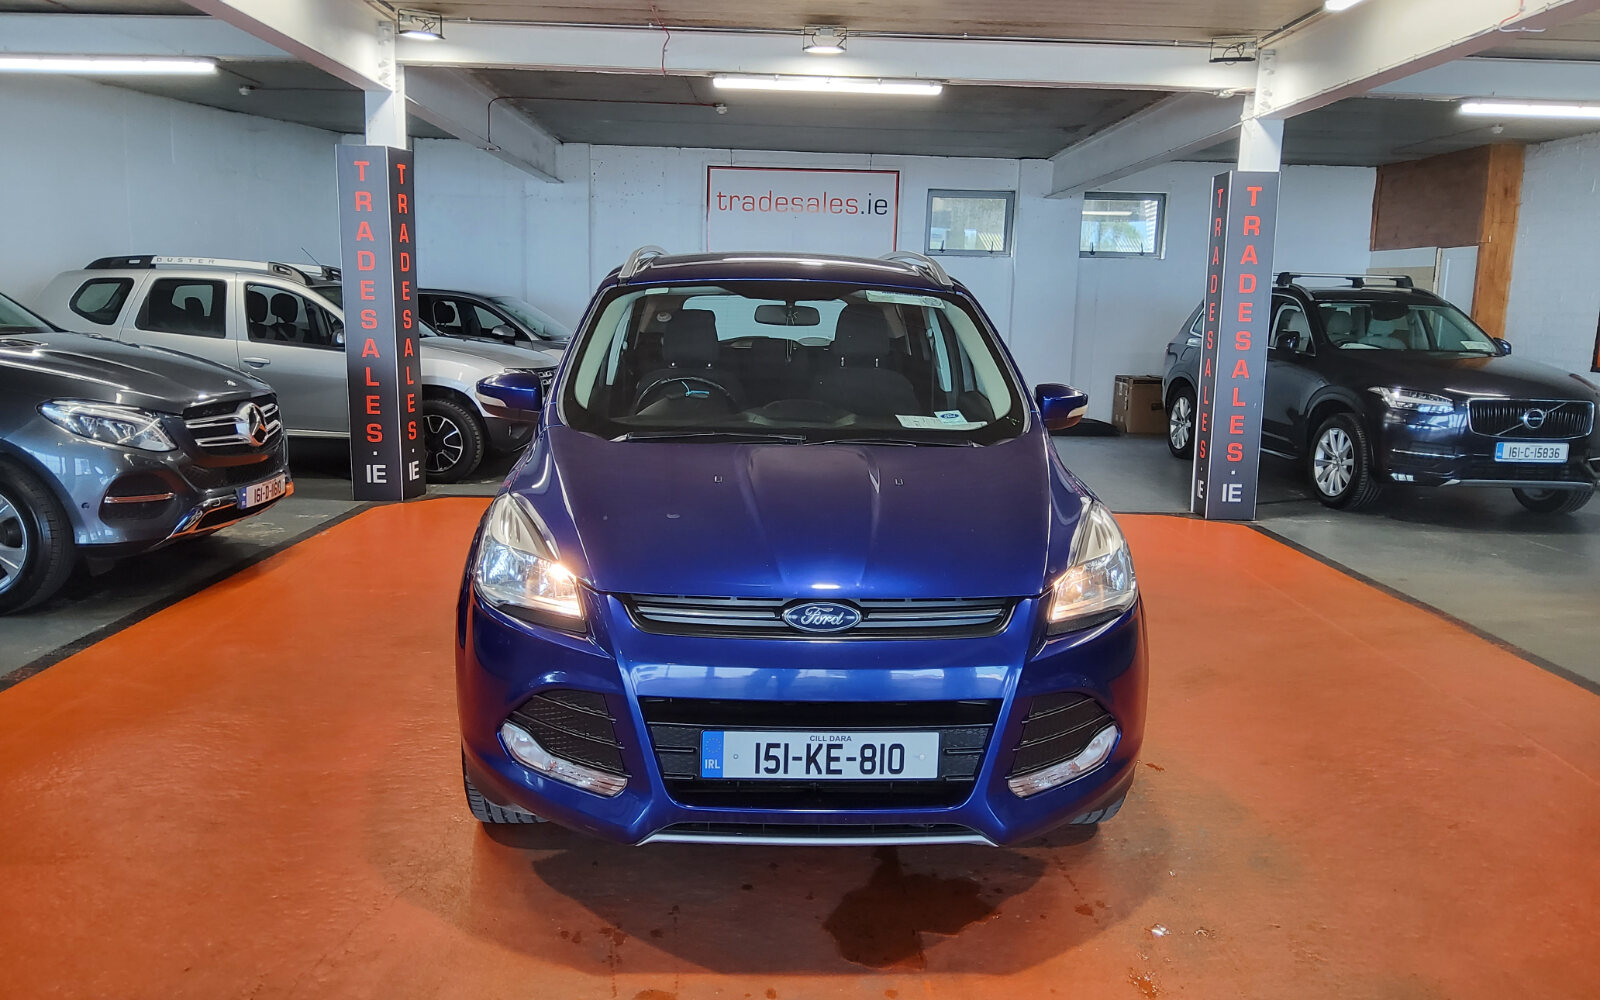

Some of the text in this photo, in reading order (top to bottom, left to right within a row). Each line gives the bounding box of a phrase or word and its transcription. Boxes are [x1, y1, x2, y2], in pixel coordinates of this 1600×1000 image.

[717, 190, 888, 215] tradesales.ie
[1508, 446, 1560, 459] 161-C-15836
[800, 606, 845, 626] Ford
[704, 759, 721, 769] IRL
[754, 743, 905, 775] 151-KE-810
